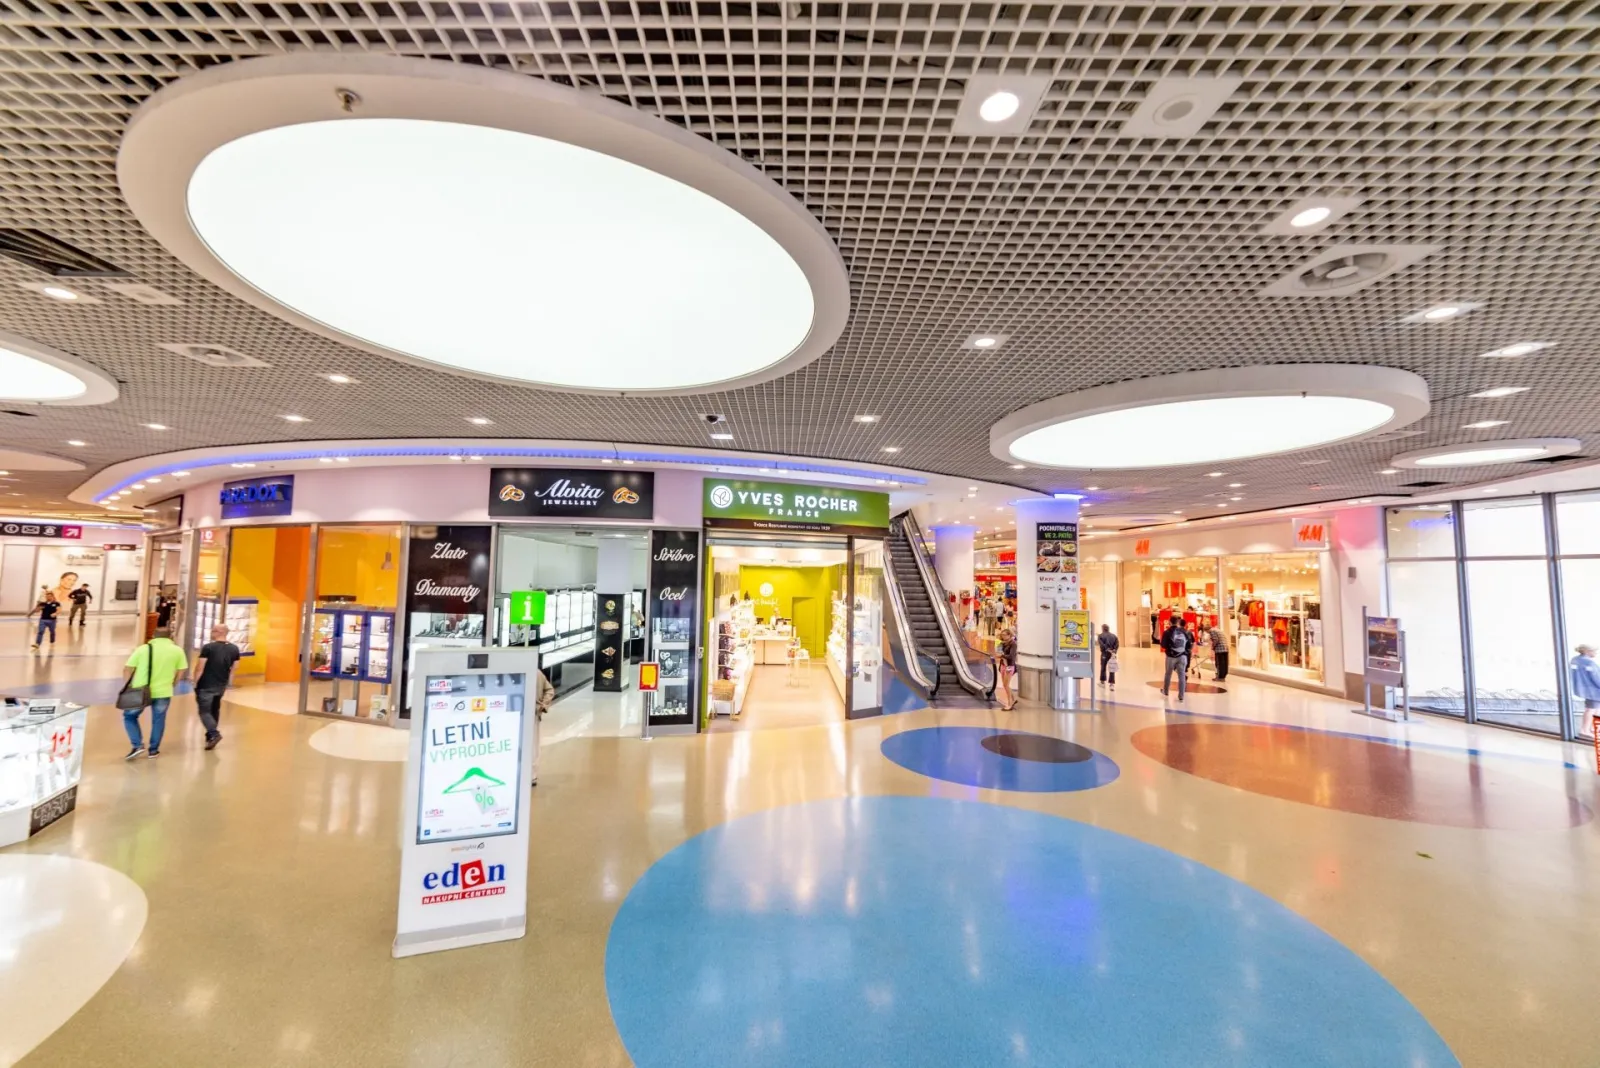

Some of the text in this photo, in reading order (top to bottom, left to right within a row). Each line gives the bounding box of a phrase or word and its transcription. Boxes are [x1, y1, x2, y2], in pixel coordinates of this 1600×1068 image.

[738, 491, 858, 512] YVES ROCHER
[769, 508, 820, 518] FRANCE
[430, 543, 468, 559] Zlato
[654, 547, 695, 562] Stříbro
[414, 579, 480, 603] Diamanty
[659, 586, 688, 601] Ocel
[51, 726, 72, 752] 1+1
[432, 716, 491, 746] LETNÍ
[430, 739, 512, 763] VÝPRODEJE
[423, 861, 506, 890] eden
[464, 887, 505, 899] CENTRUM
